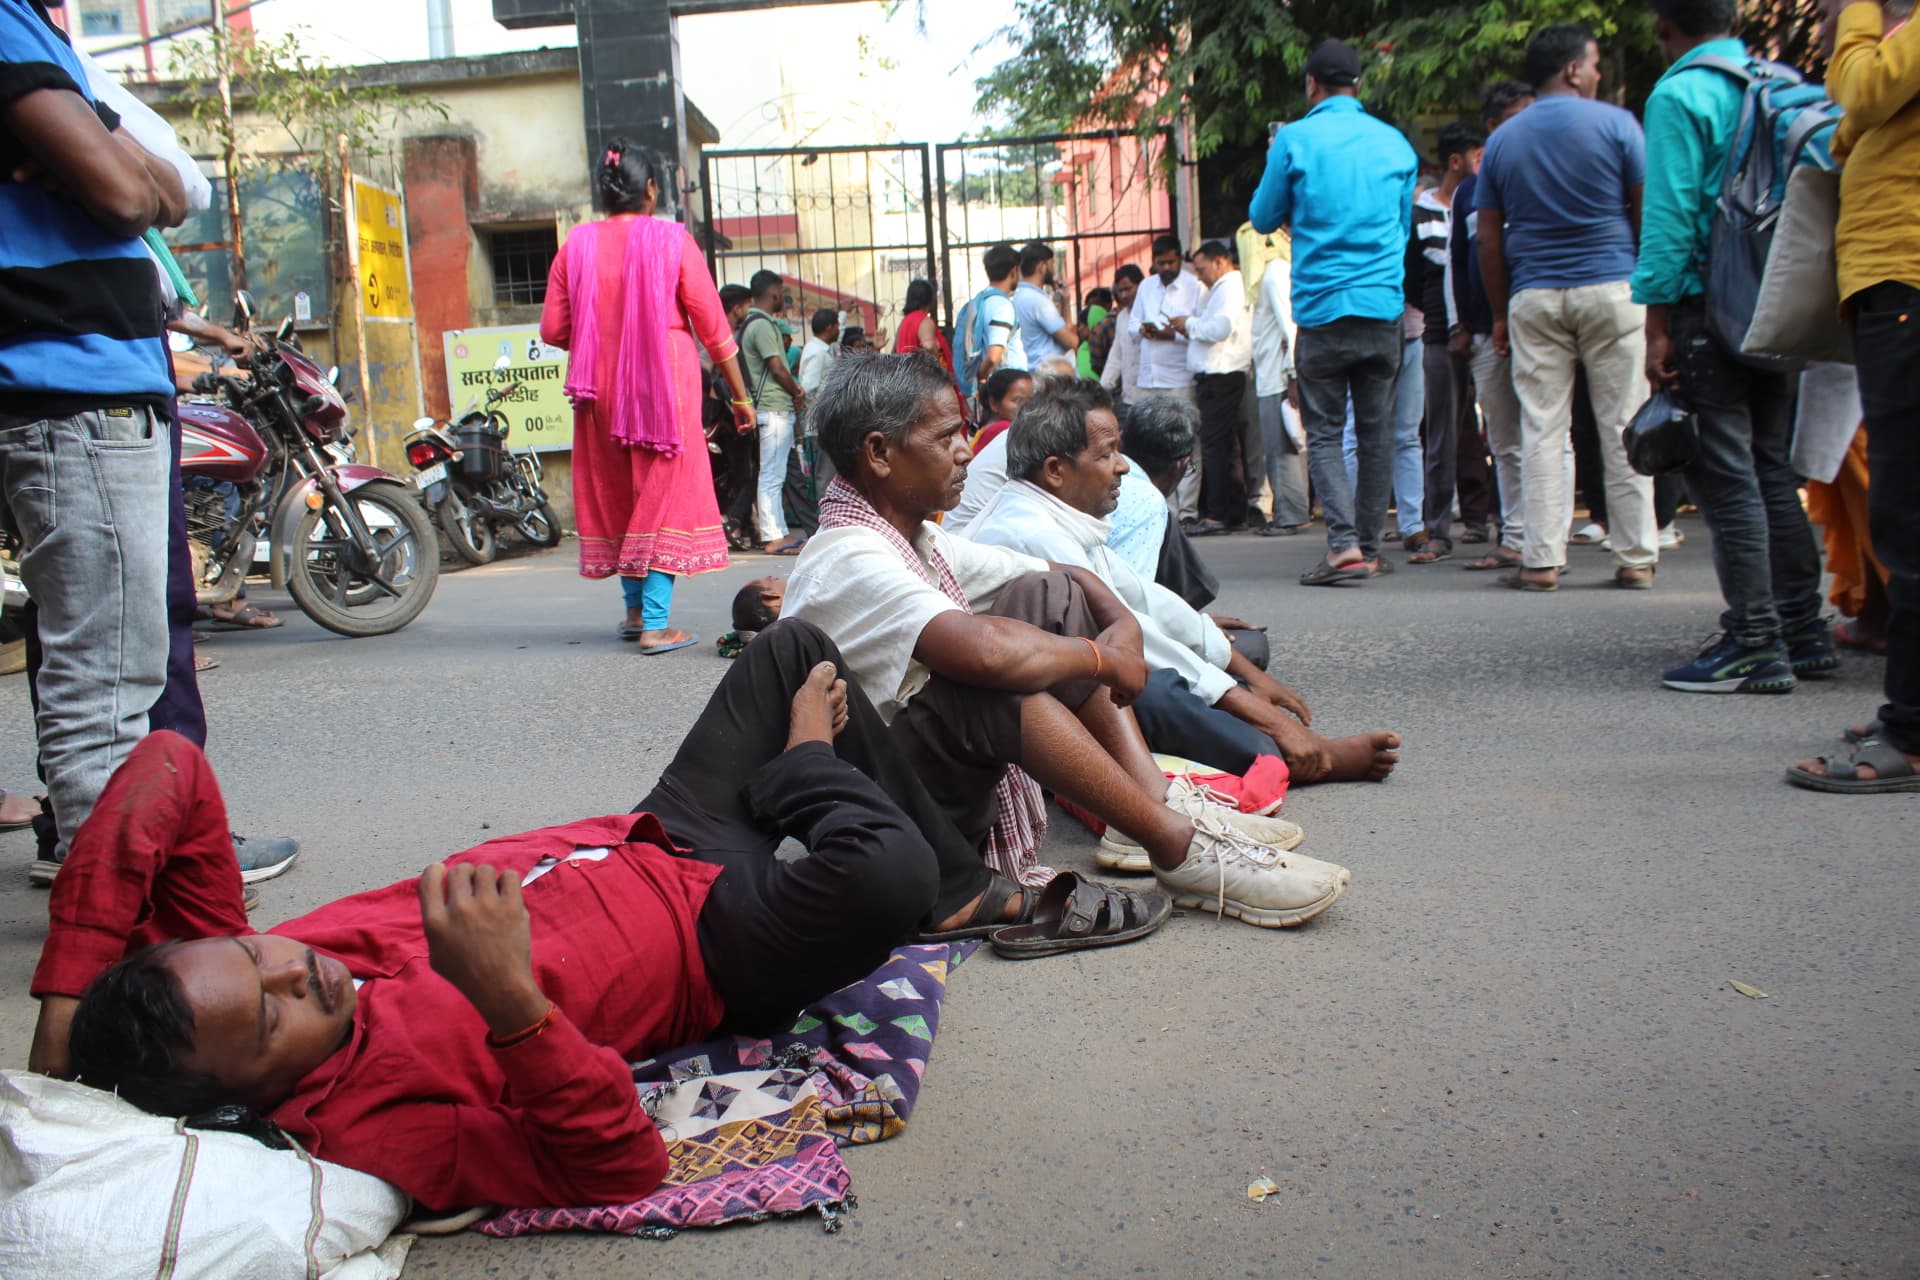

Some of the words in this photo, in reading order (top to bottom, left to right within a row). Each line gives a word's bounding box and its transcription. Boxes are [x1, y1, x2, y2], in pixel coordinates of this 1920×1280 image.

[461, 370, 492, 386] सदर
[497, 365, 560, 384] अस्पताल
[525, 417, 544, 432] 00
